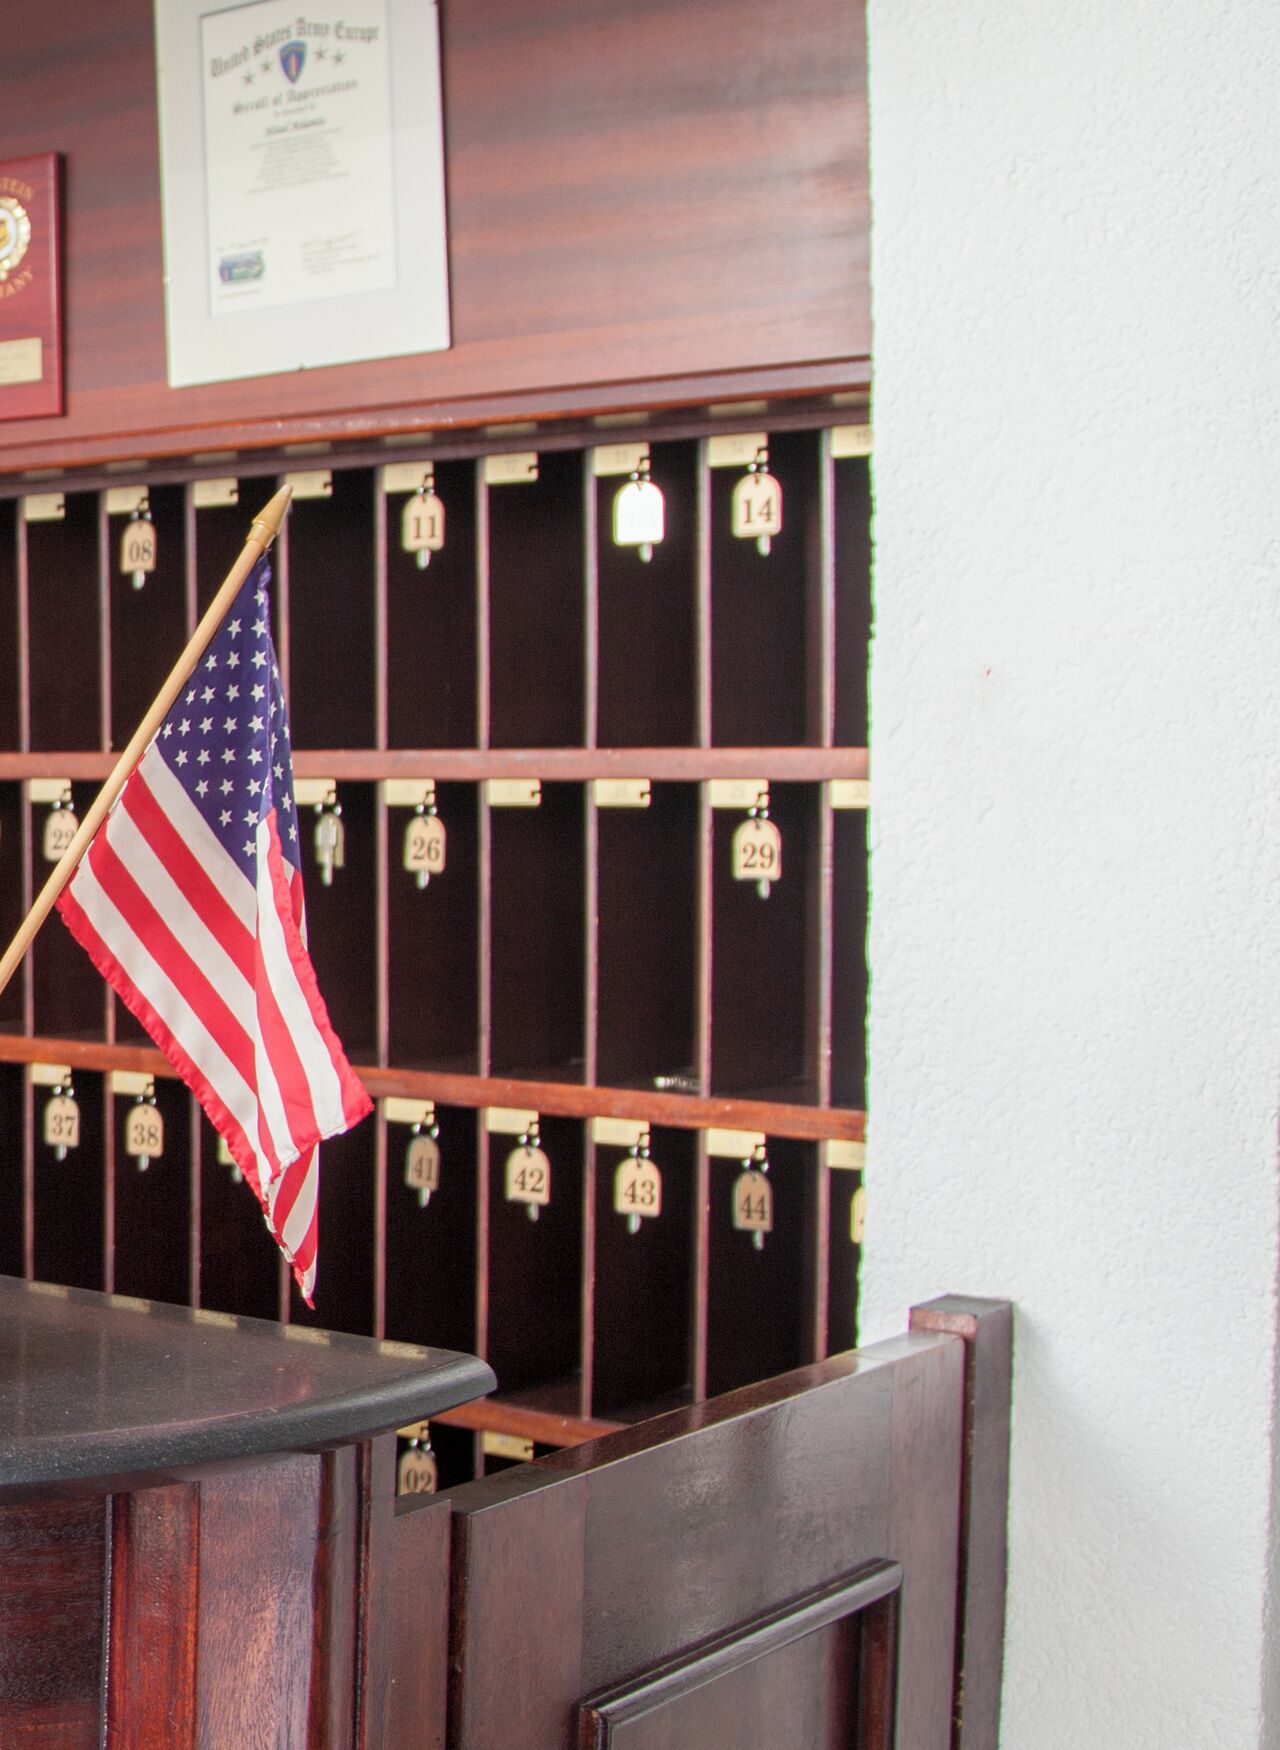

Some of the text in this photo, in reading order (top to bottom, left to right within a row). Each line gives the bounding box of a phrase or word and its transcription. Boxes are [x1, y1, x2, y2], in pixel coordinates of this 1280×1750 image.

[254, 25, 292, 56] States
[296, 17, 331, 38] Army
[334, 20, 381, 44] Europe
[743, 497, 773, 524] 14
[414, 516, 437, 540] 11
[129, 540, 152, 563] 08
[53, 827, 75, 851] 22
[413, 835, 441, 862] 26
[742, 842, 774, 869] 29
[52, 1113, 75, 1137] 37
[134, 1122, 159, 1147] 38
[414, 1156, 434, 1182] 41
[515, 1167, 545, 1194] 42
[625, 1178, 655, 1206] 43
[741, 1192, 767, 1221] 44
[405, 1468, 432, 1493] 02
